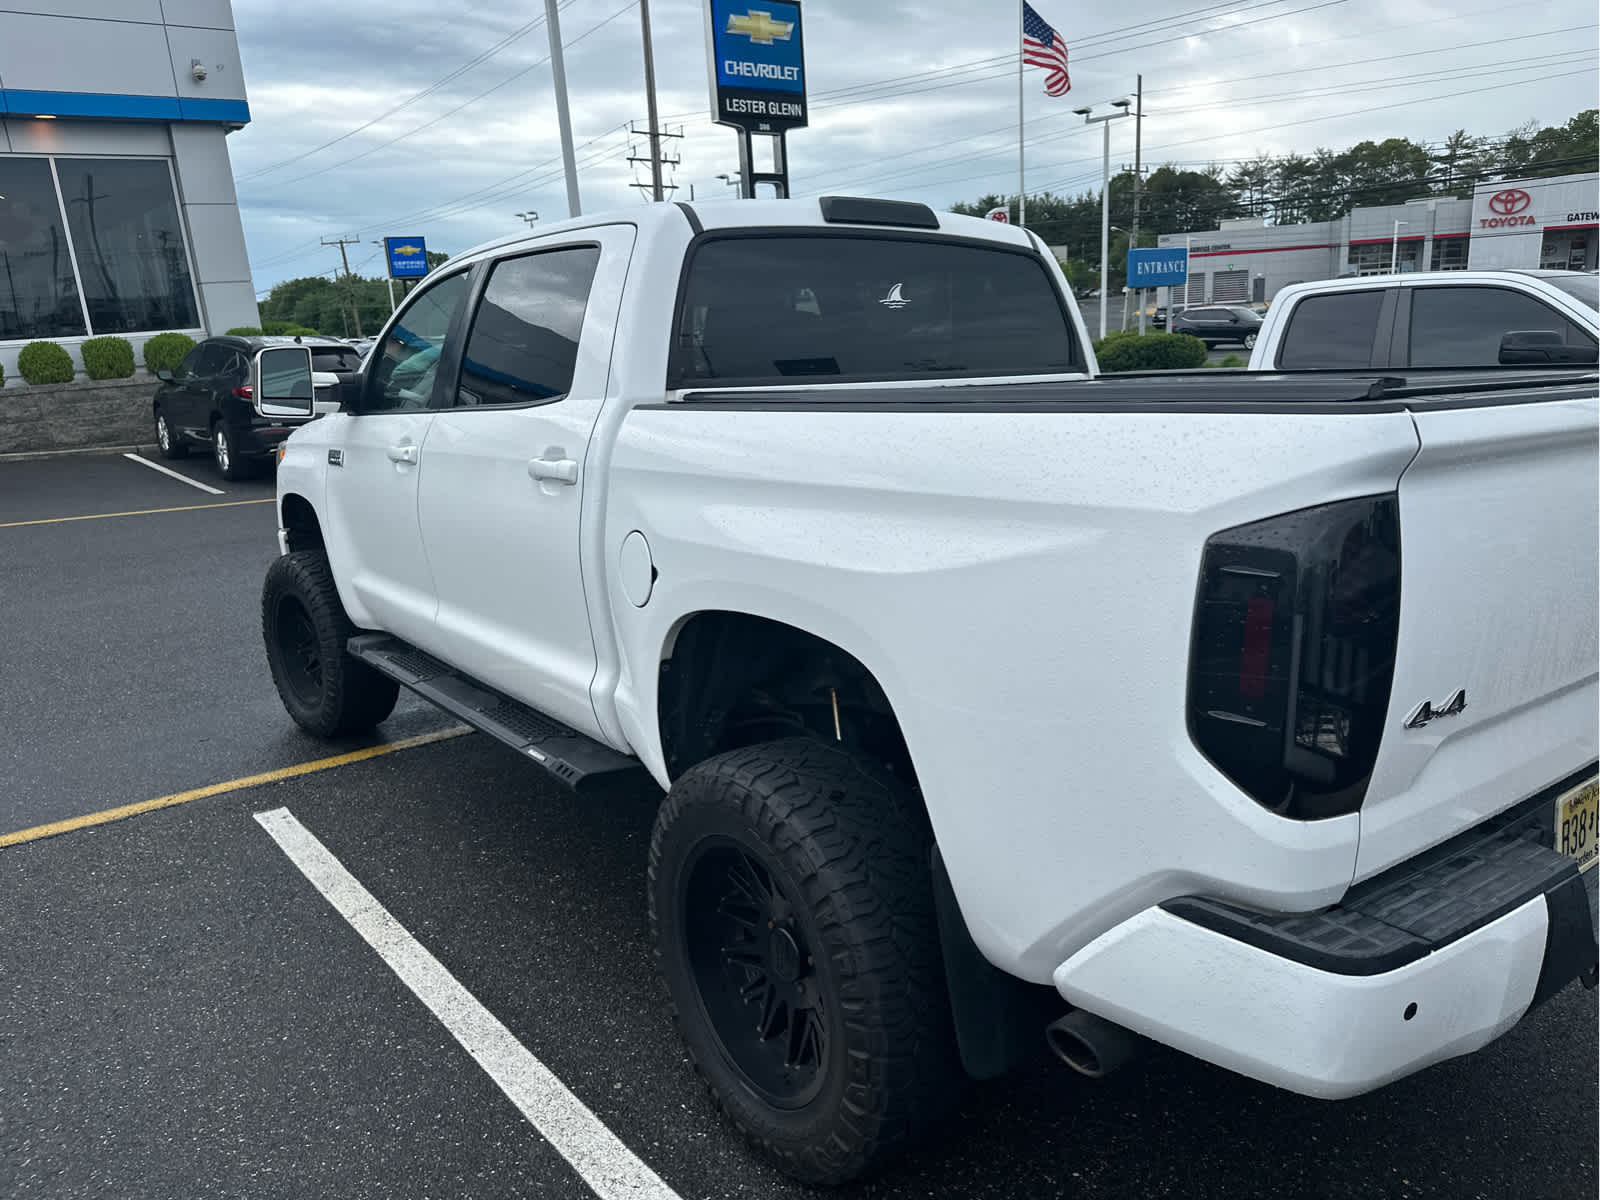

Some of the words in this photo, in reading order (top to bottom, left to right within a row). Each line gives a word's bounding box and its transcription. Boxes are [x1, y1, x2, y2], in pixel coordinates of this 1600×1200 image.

[724, 60, 800, 80] CHEVROLET
[726, 98, 767, 114] LESTER
[768, 101, 802, 117] GLENN
[1480, 215, 1536, 229] TOYOTA
[1137, 260, 1185, 275] ENTRANCE
